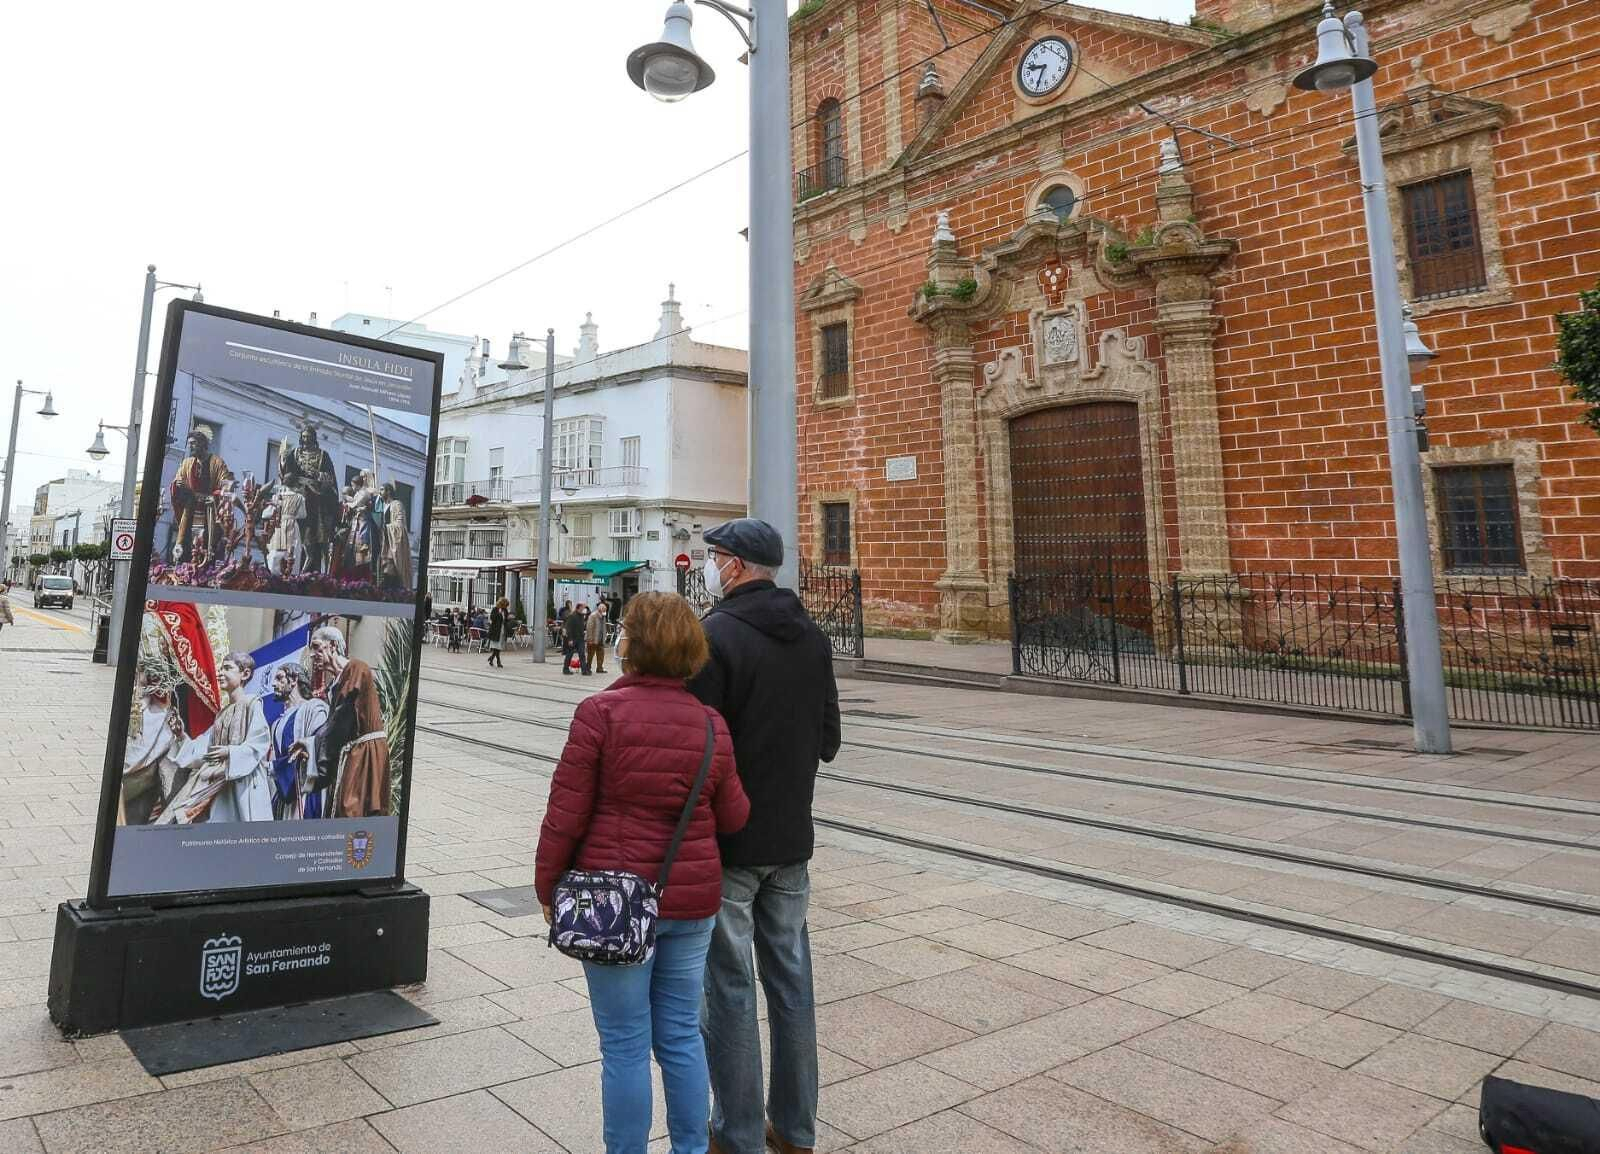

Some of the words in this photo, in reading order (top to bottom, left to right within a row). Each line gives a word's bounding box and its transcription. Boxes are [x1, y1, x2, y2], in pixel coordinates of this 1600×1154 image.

[338, 352, 380, 370] INSULA
[384, 362, 413, 377] FIDEI
[207, 952, 236, 968] SAN
[246, 944, 317, 963] Ayuntamiento
[318, 942, 331, 952] de
[245, 963, 270, 975] San
[272, 953, 330, 972] Fernando
